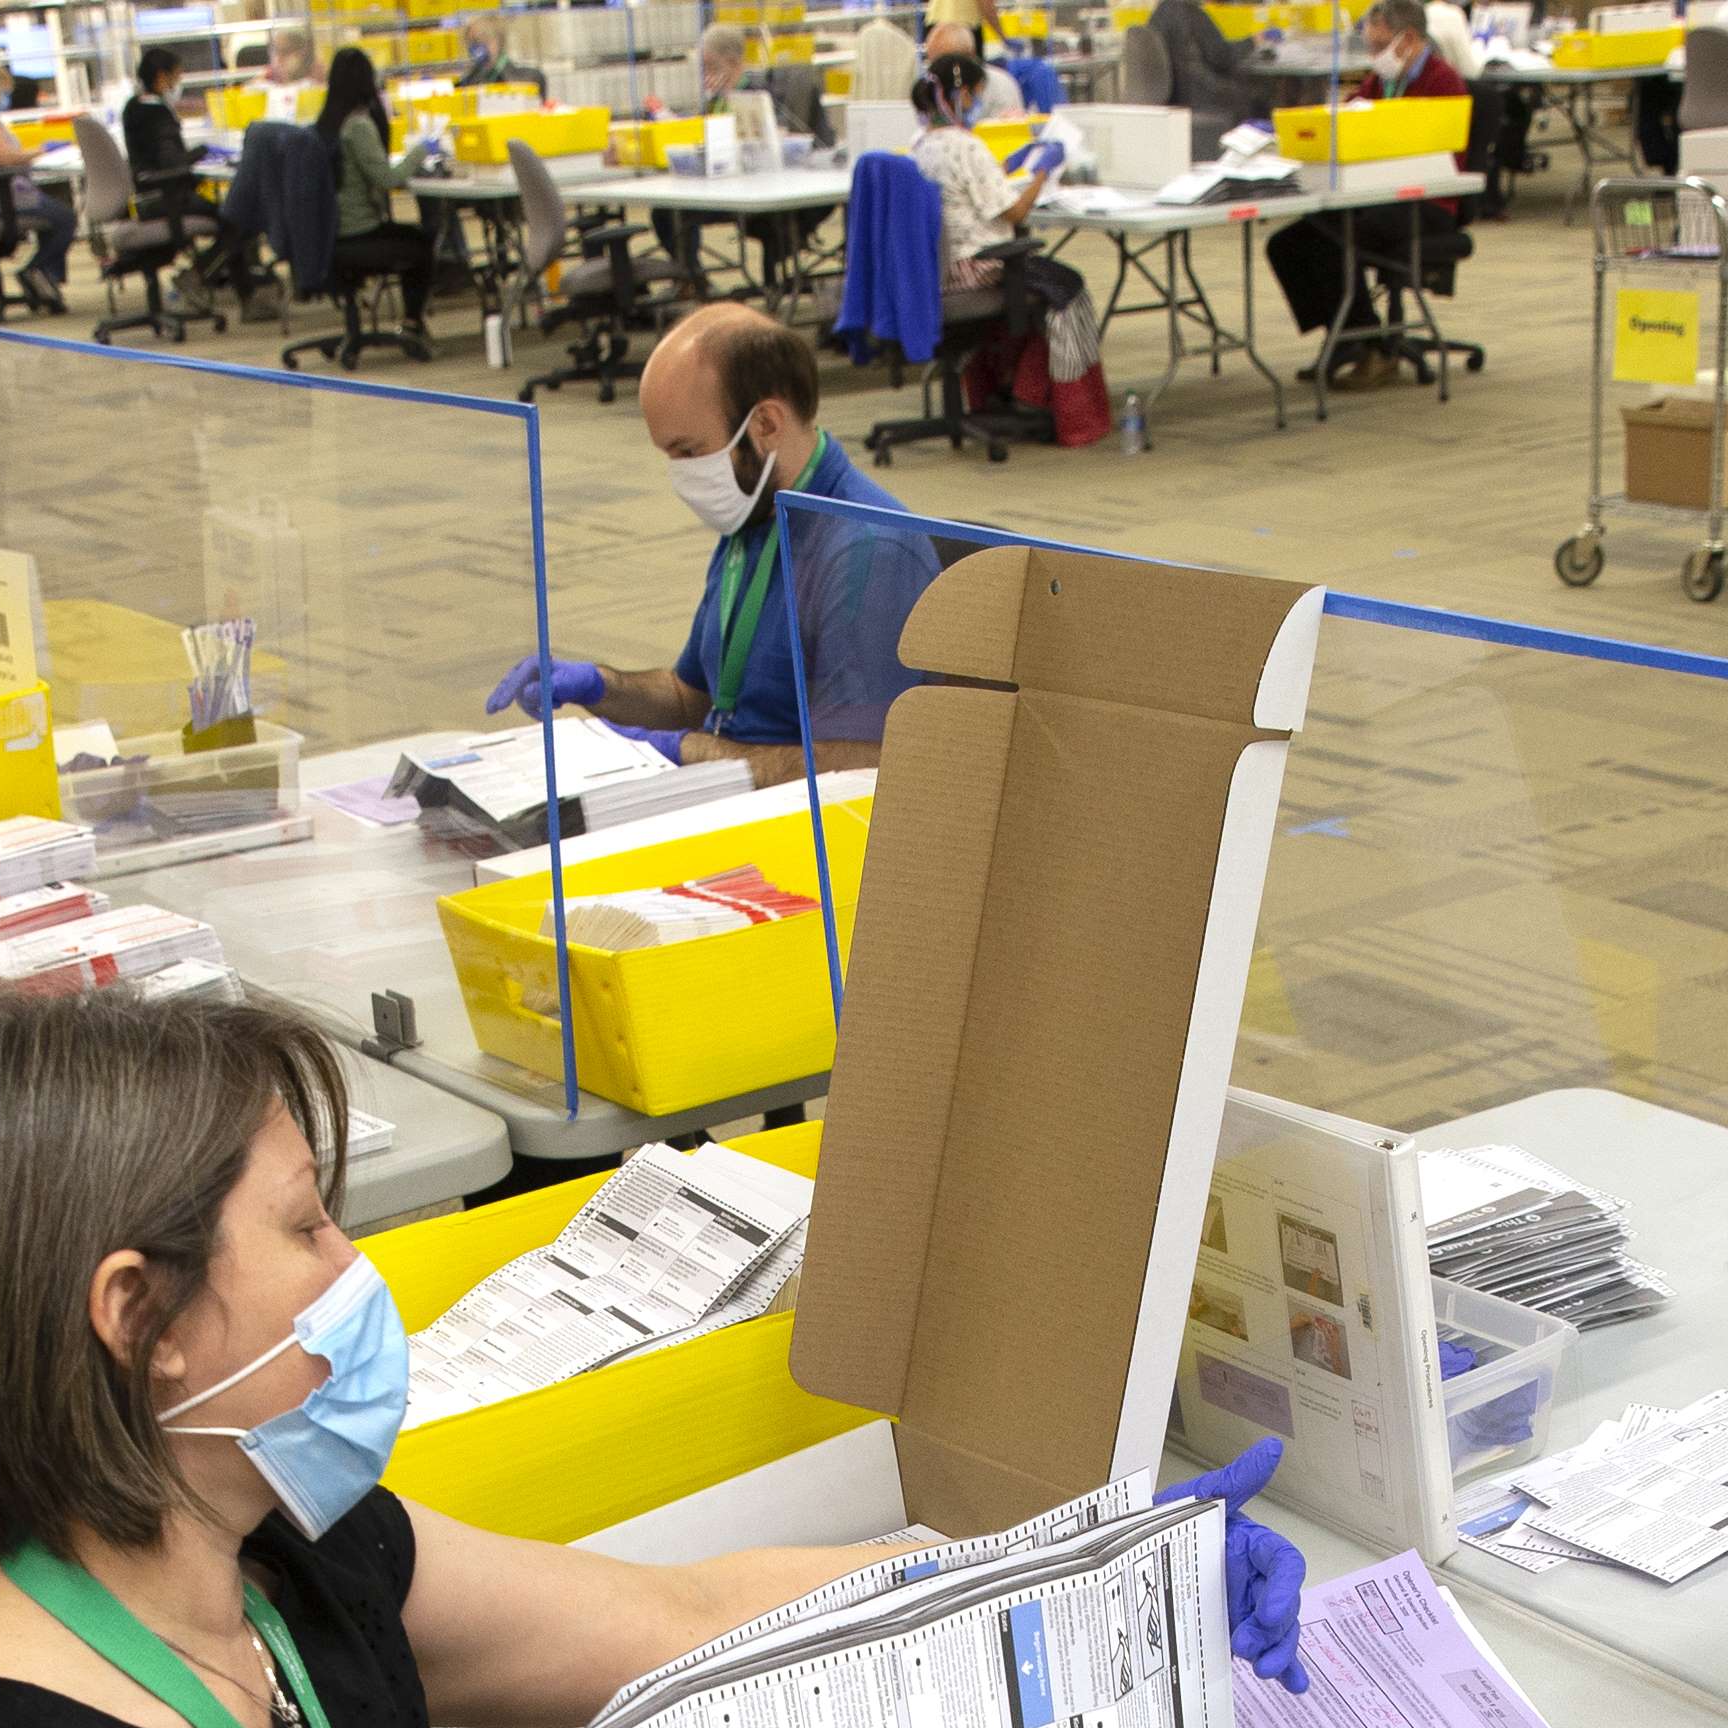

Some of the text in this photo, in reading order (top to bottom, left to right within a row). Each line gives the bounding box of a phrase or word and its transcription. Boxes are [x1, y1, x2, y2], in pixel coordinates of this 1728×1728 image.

[1628, 313, 1685, 341] Opening
[1420, 1329, 1434, 1408] Opening Procedures
[1161, 1545, 1170, 1590] Instructions
[1000, 1610, 1009, 1633] State
[1400, 1570, 1441, 1625] Opener's Checklist
[1032, 1629, 1047, 1696] Begin voting here
